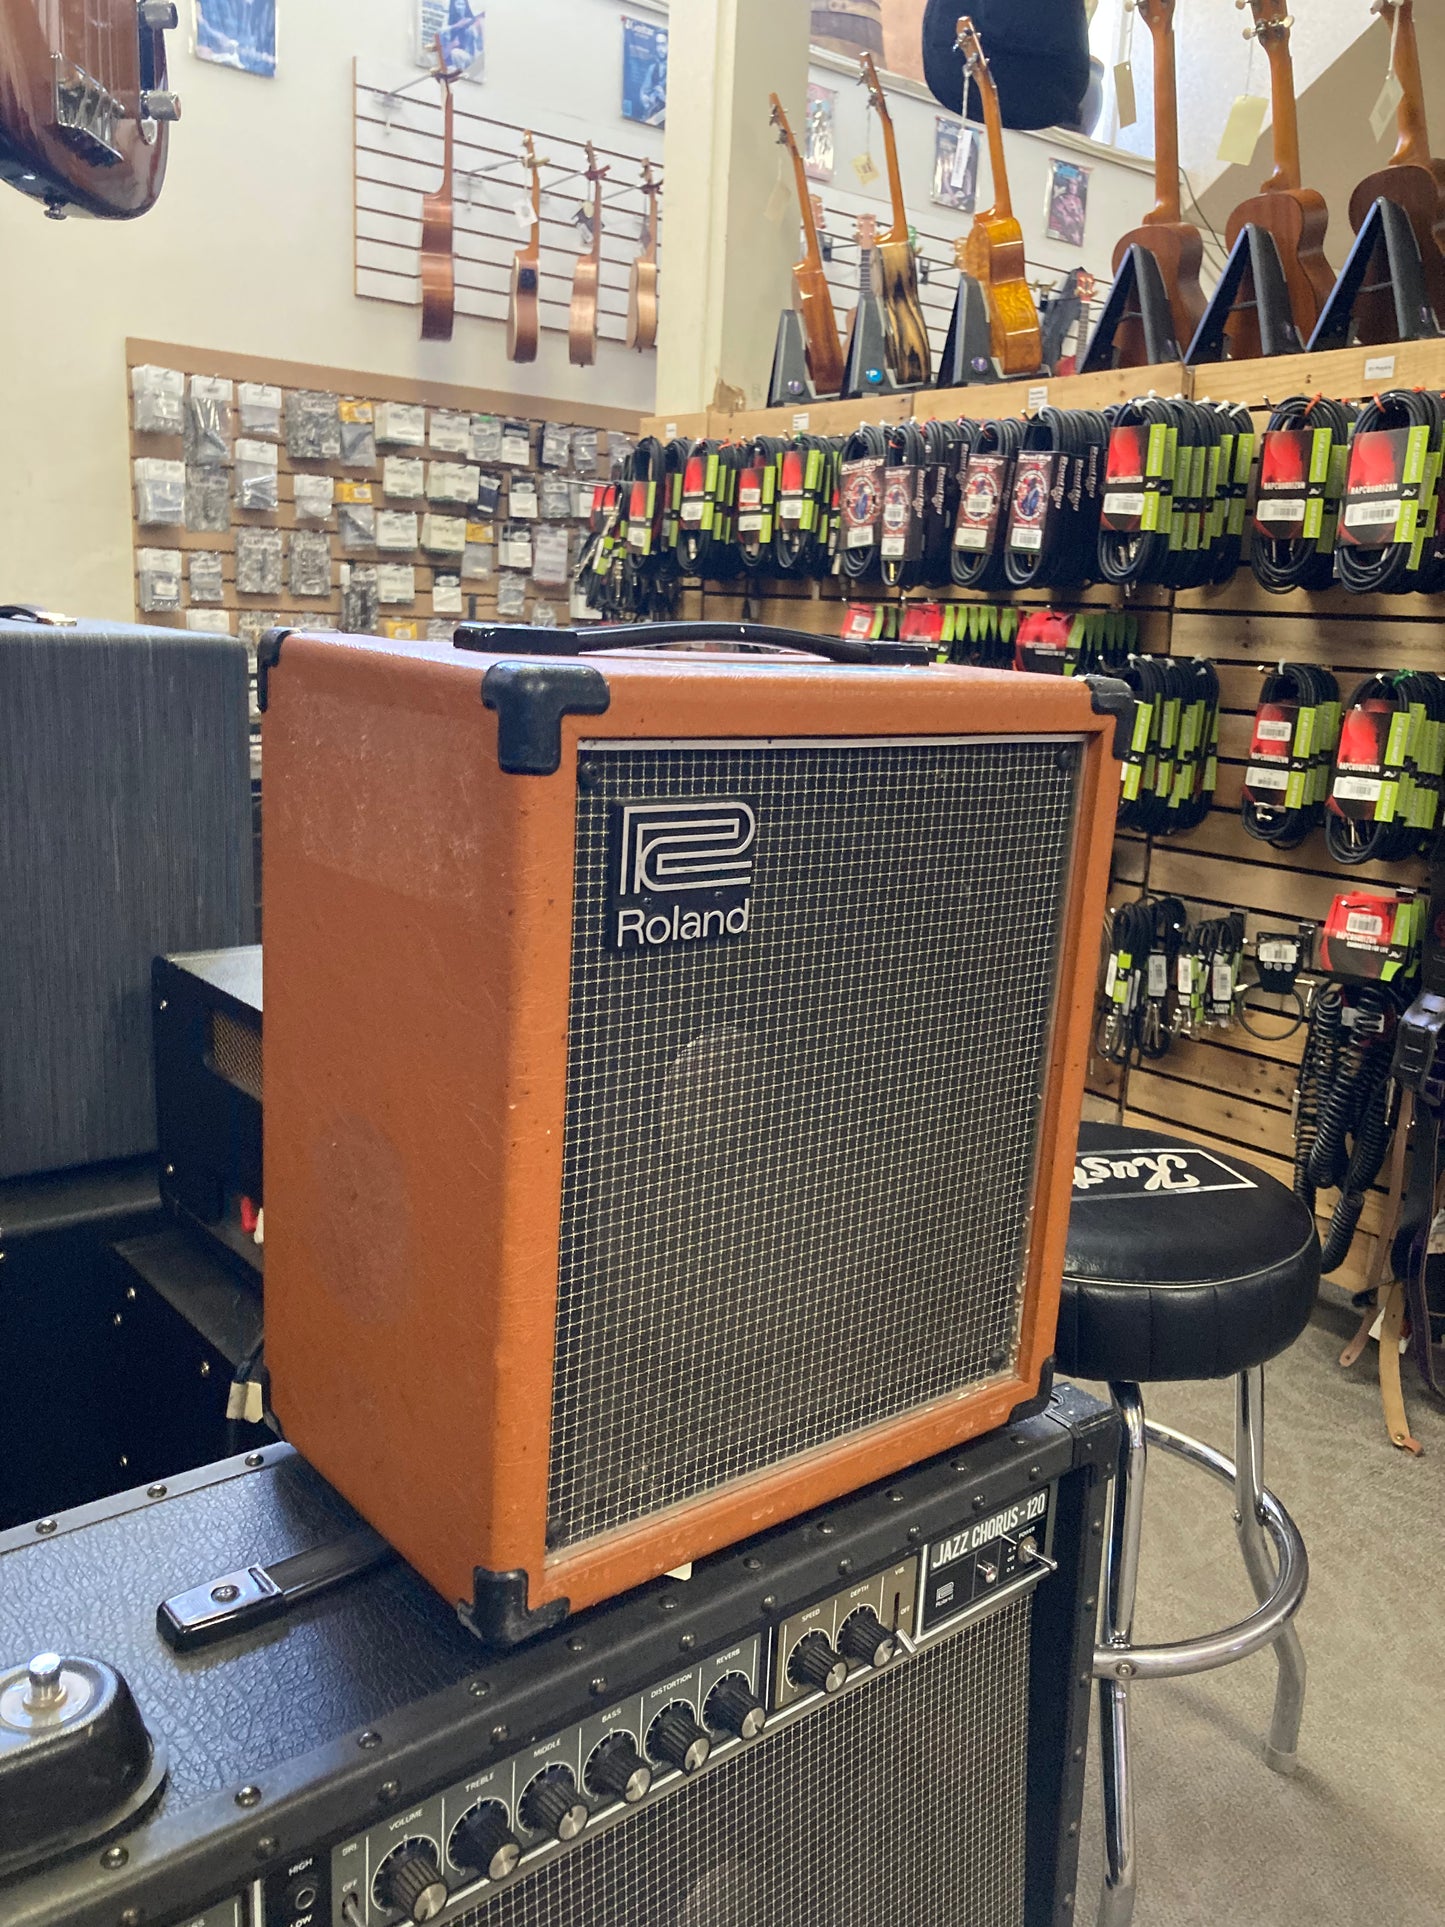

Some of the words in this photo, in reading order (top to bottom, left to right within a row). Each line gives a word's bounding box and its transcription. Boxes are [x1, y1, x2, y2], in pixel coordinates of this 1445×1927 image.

[618, 898, 750, 948] Roland
[932, 1530, 969, 1569] JAZZ
[849, 1584, 870, 1599] DEPTH
[801, 1608, 821, 1623] SPEED
[716, 1648, 741, 1666] REVERB
[650, 1672, 693, 1699] DISTORTION
[601, 1707, 622, 1724] BASS
[533, 1738, 561, 1758] MIDDLE
[465, 1771, 495, 1793] TREBLE
[388, 1808, 424, 1831] VOLUME
[288, 1857, 313, 1877] HIGH
[342, 1878, 358, 1893] OFF
